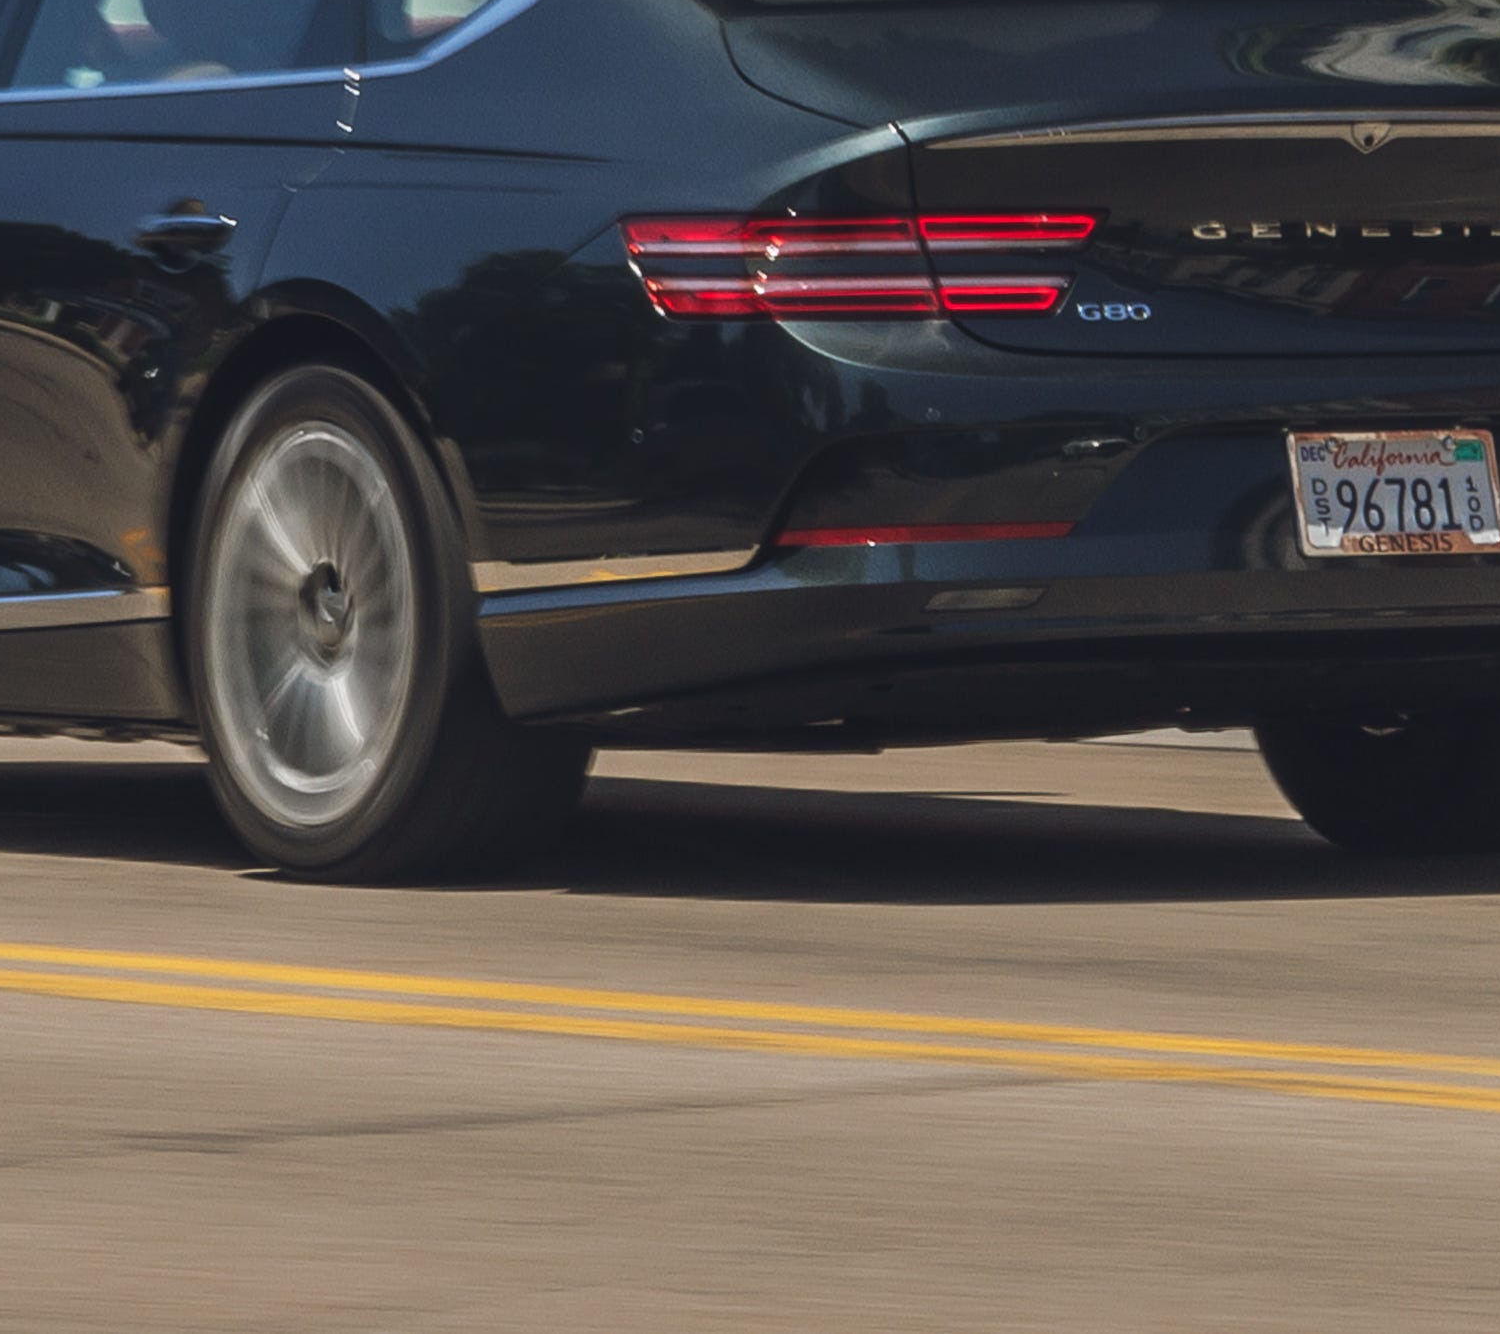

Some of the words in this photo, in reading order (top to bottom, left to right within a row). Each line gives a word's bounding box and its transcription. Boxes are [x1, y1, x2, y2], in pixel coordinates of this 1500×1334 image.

[1077, 302, 1152, 322] G80
[1301, 446, 1326, 463] DEC
[1331, 441, 1456, 476] California
[1336, 477, 1463, 533] 96781
[1357, 534, 1454, 553] GENESIS
